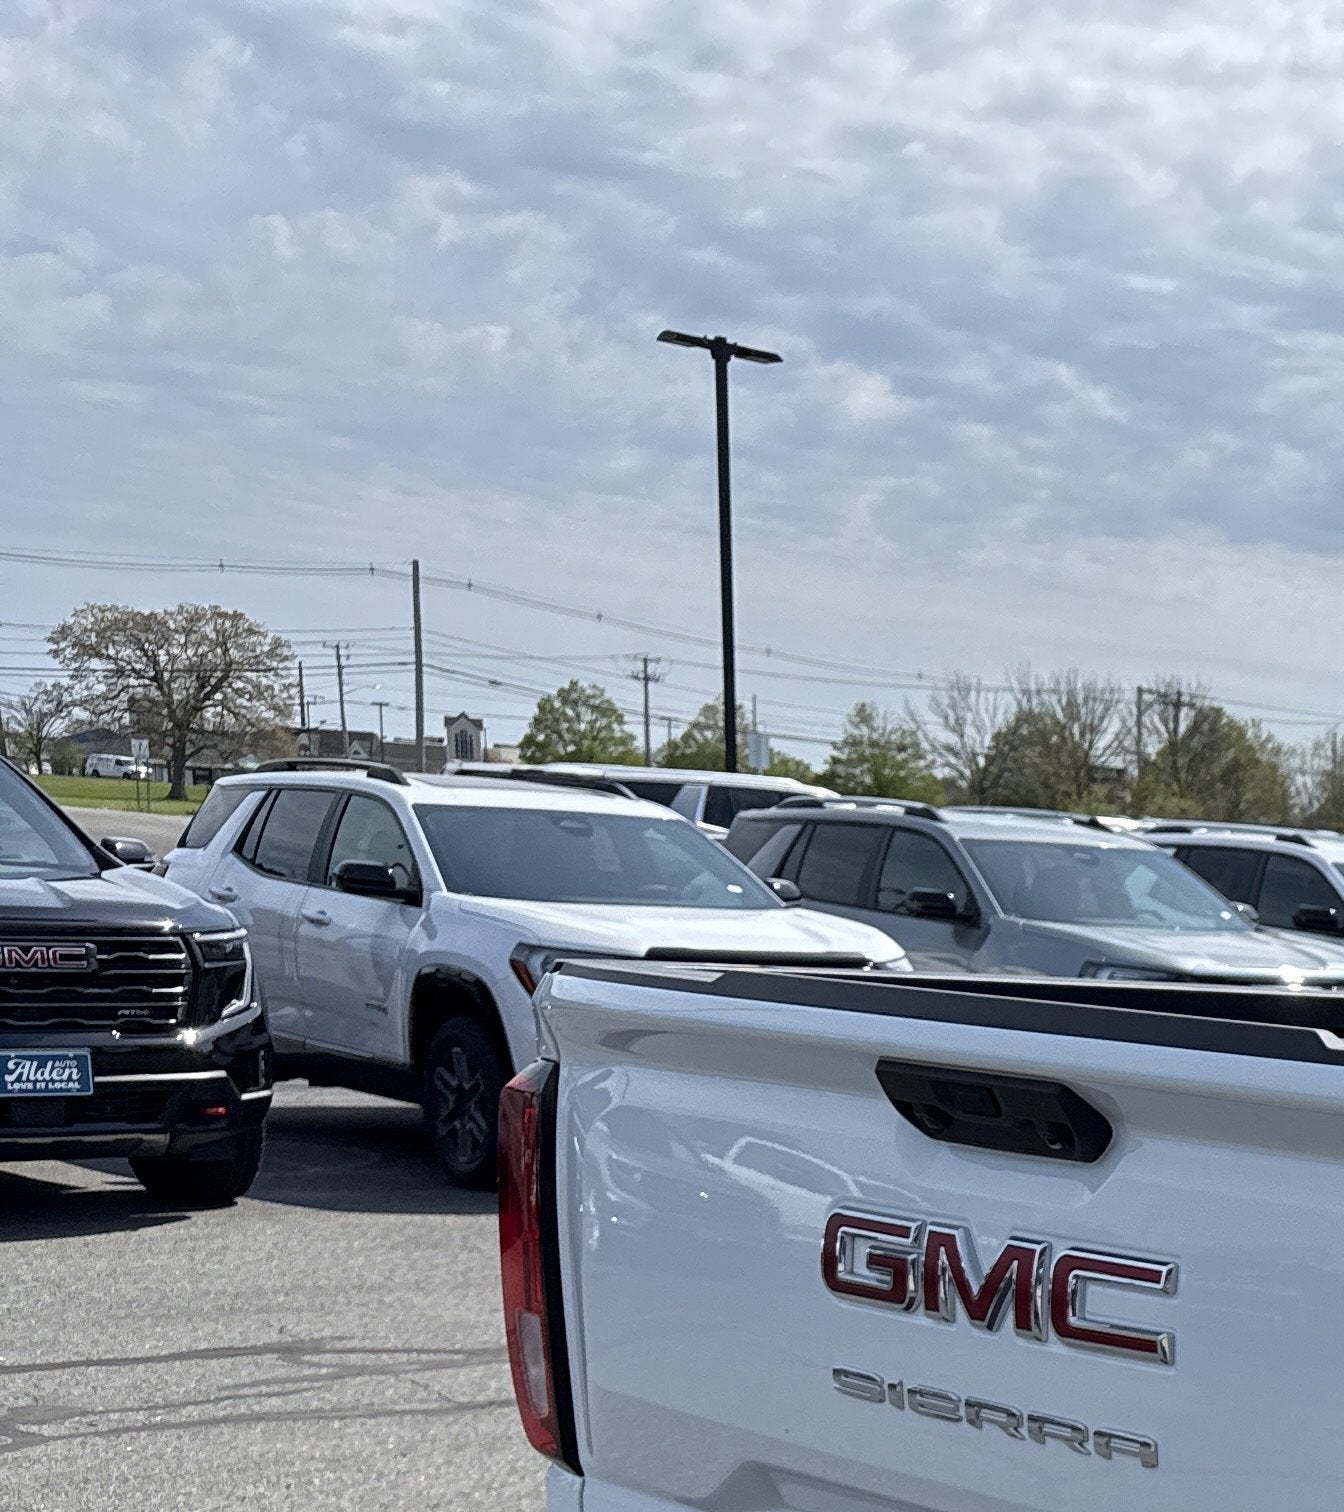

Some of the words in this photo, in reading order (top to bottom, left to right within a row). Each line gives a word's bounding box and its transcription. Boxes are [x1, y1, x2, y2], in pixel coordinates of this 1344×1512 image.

[0, 946, 88, 968] MC
[4, 1058, 82, 1082] Alden
[53, 1059, 78, 1068] AUTO
[7, 1081, 34, 1090] LOVE
[36, 1081, 46, 1090] IT
[48, 1081, 81, 1090] LOCAL
[820, 1205, 1180, 1367] GMC
[832, 1364, 1159, 1469] SIERRA
